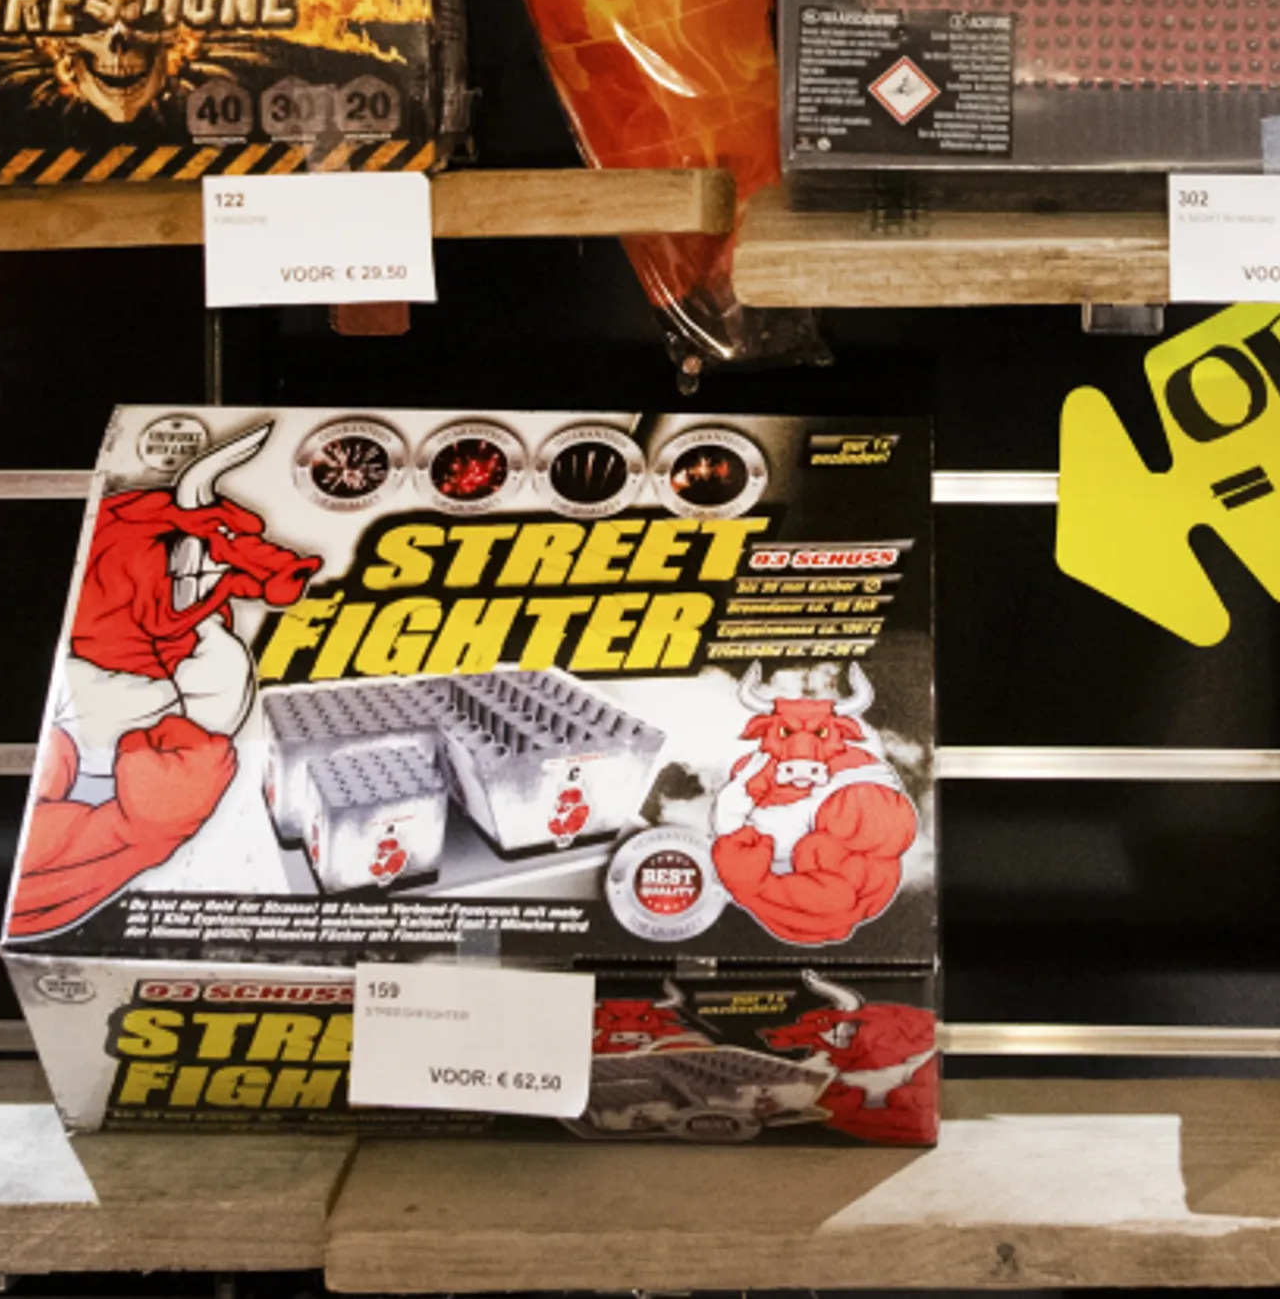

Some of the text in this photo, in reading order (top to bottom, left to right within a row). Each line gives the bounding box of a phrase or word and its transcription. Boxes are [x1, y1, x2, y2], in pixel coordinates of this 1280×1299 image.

[196, 90, 391, 125] 40 30 20
[214, 193, 244, 208] 122
[1179, 190, 1209, 208] 302
[362, 517, 771, 591] STREET
[792, 549, 899, 568] SCHUSS
[257, 590, 714, 681] FIGHTER
[641, 867, 697, 884] BEST
[139, 981, 355, 1003] 93 SCHUSS
[368, 982, 401, 999] 159
[117, 1008, 353, 1063] STRE
[120, 1061, 349, 1108] FIGH
[429, 1066, 562, 1092] VOOR: € 62,50
